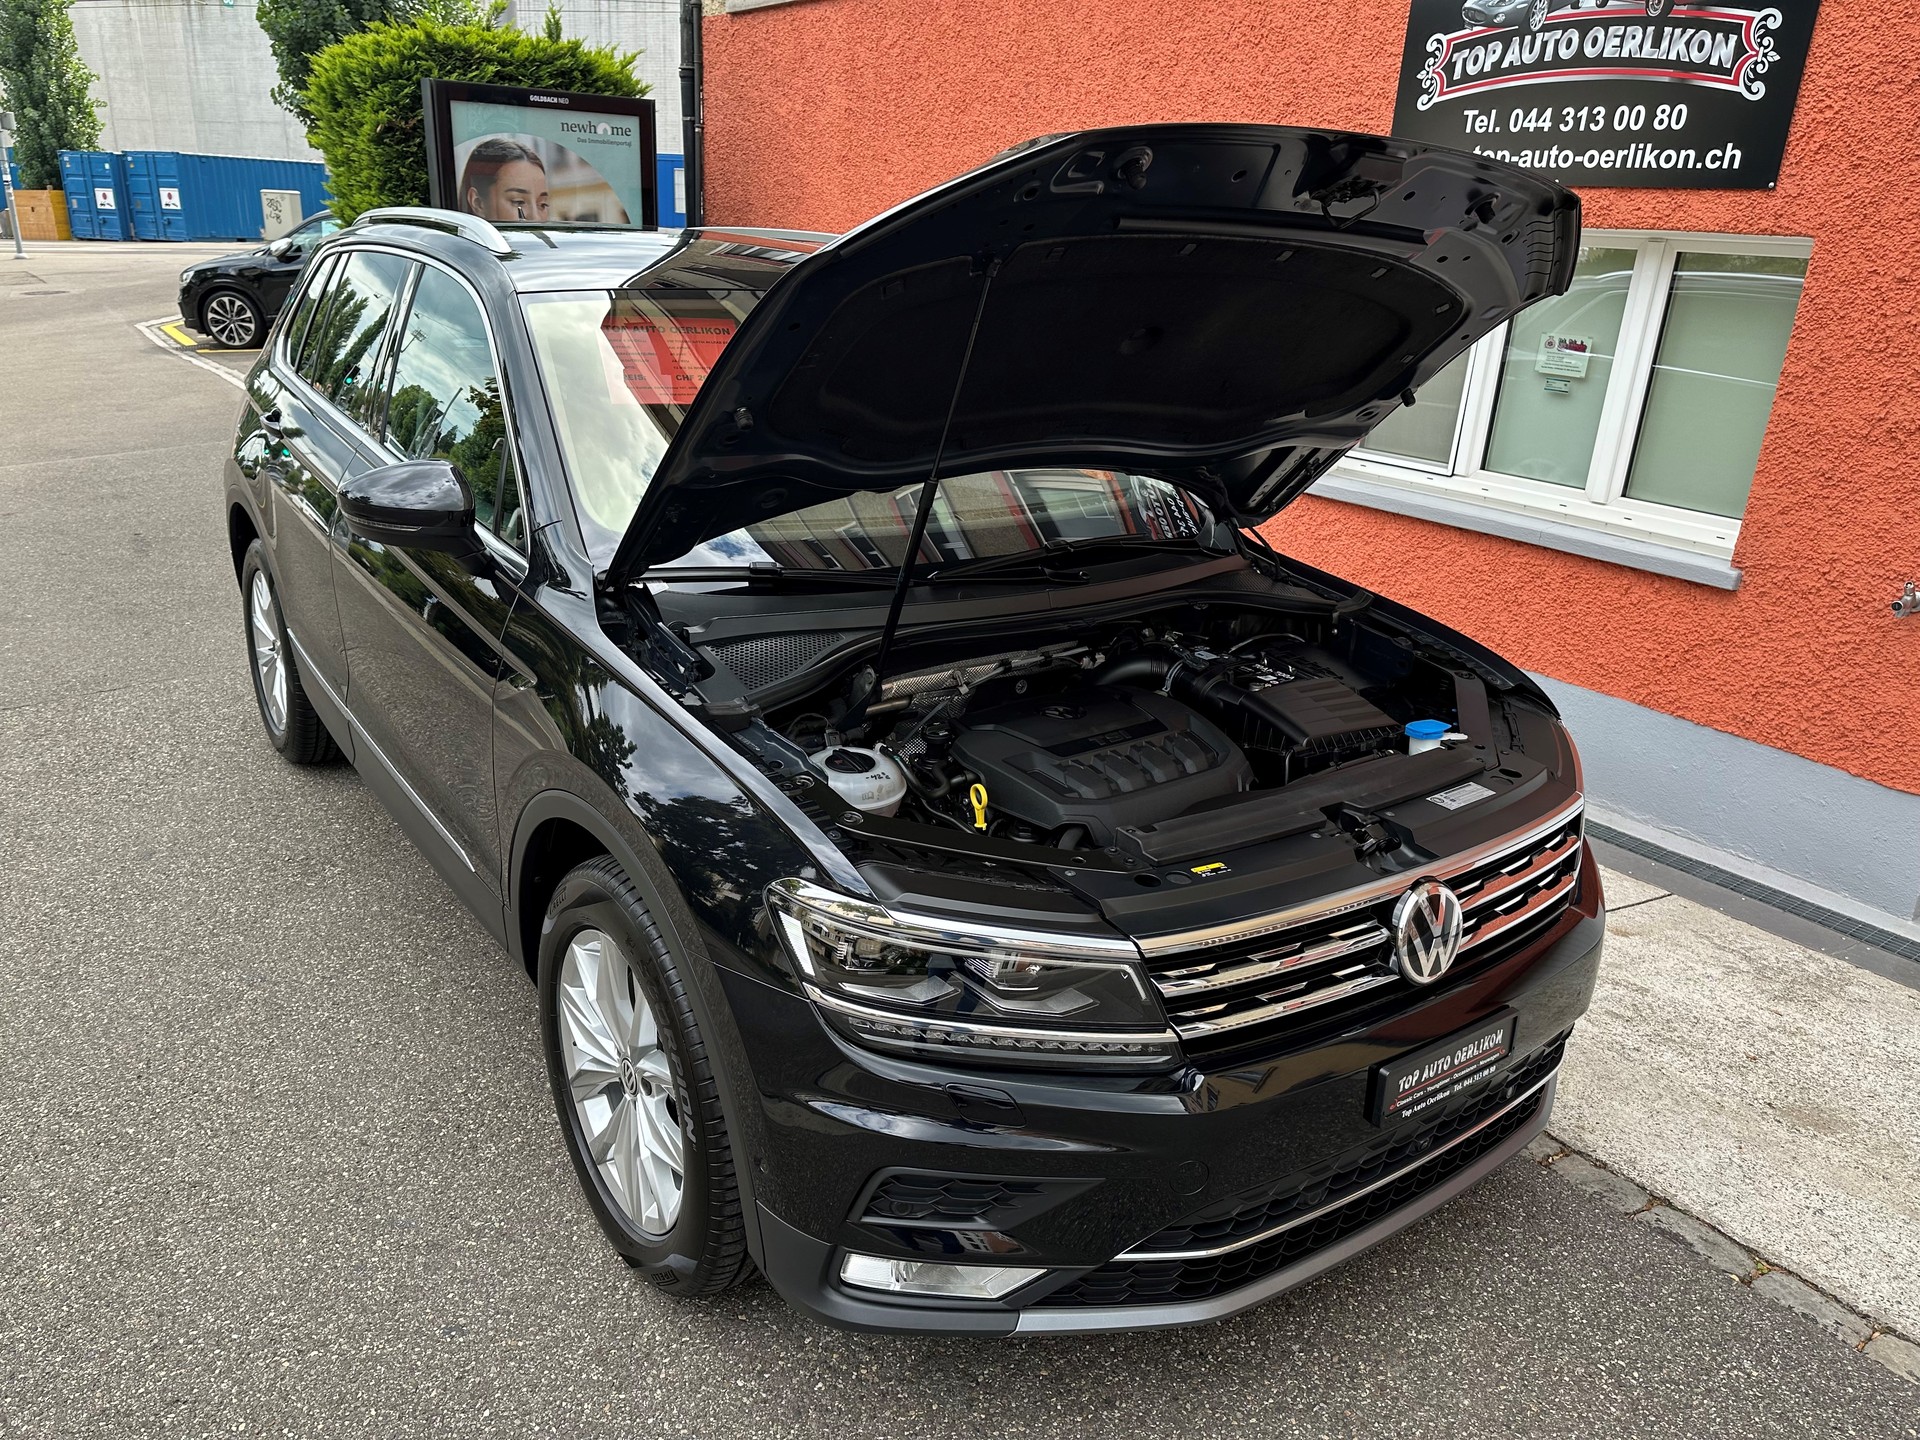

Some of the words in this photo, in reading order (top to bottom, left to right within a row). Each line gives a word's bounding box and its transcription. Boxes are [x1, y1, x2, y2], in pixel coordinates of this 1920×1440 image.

[1452, 47, 1500, 80] TOP
[1500, 29, 1578, 69] AUTO
[1584, 26, 1738, 69] OERLIKON
[1463, 109, 1501, 133] Tel.
[1509, 107, 1553, 133] 044
[1559, 106, 1604, 132] 313
[1613, 105, 1645, 131] 00
[1653, 104, 1687, 130] 80
[669, 325, 731, 336] OERLIKON
[1398, 1069, 1420, 1093] TOP
[1421, 1055, 1451, 1082] AUTO
[1453, 1029, 1504, 1065] OERLIKON
[1401, 1107, 1413, 1118] Top
[1413, 1101, 1427, 1113] Auto
[1427, 1090, 1450, 1106] Oerlikon
